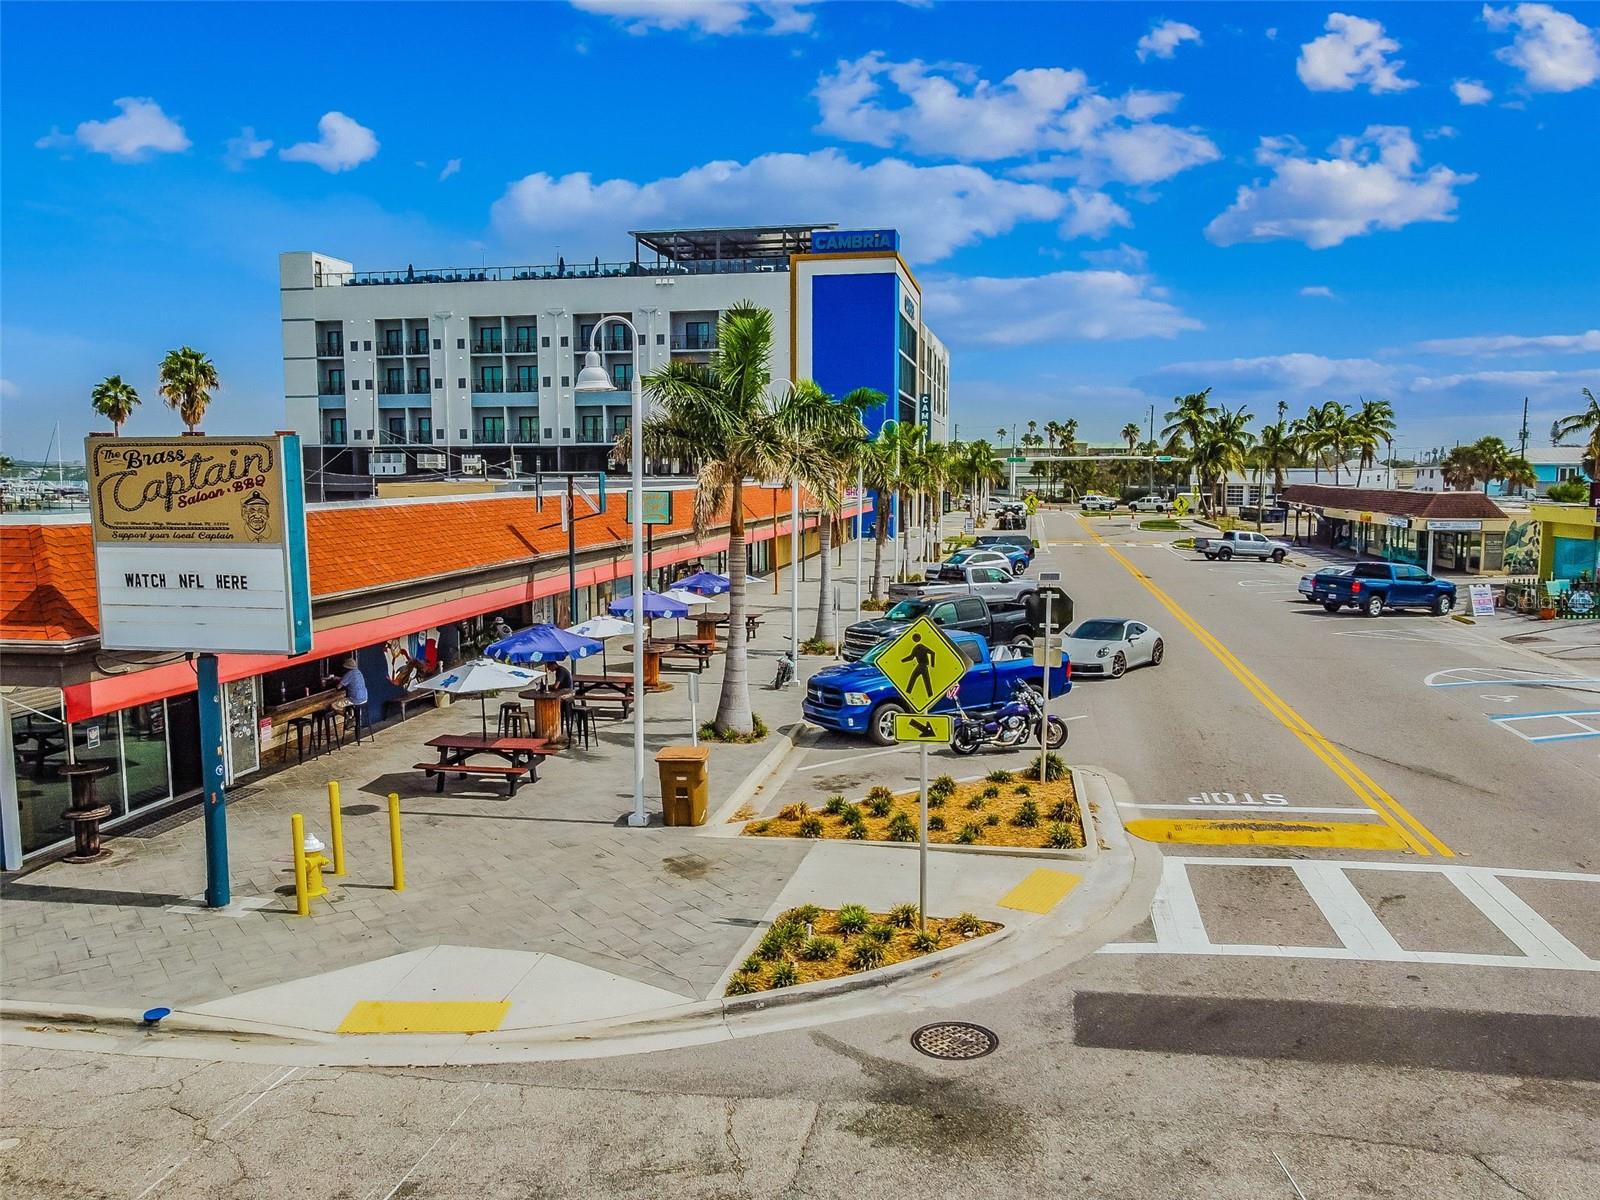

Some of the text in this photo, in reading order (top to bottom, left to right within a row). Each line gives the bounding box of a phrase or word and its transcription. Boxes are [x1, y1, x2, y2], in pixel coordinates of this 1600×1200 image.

[100, 449, 186, 469] The Brass
[113, 448, 270, 512] Captain
[177, 474, 266, 508] Saloon BBQ
[111, 530, 234, 541] Support your local Captain
[124, 573, 248, 590] WATCH NFL HERE
[1187, 792, 1289, 805] STOP
